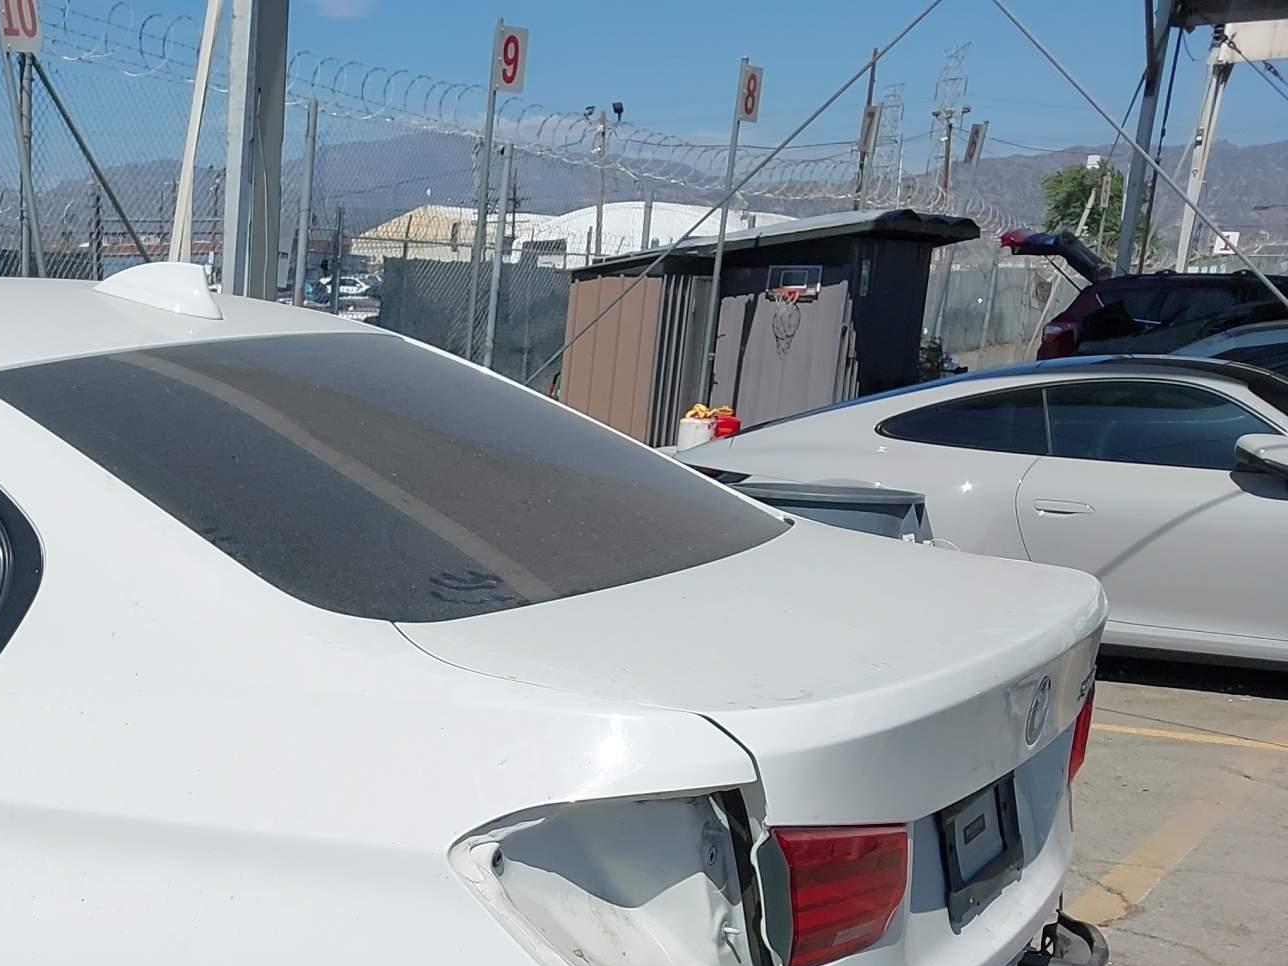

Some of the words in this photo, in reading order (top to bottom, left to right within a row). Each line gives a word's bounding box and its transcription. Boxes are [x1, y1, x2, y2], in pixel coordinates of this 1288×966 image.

[3, 0, 37, 38] 10
[502, 34, 520, 84] 9
[744, 73, 757, 115] 8
[864, 110, 876, 147] 7
